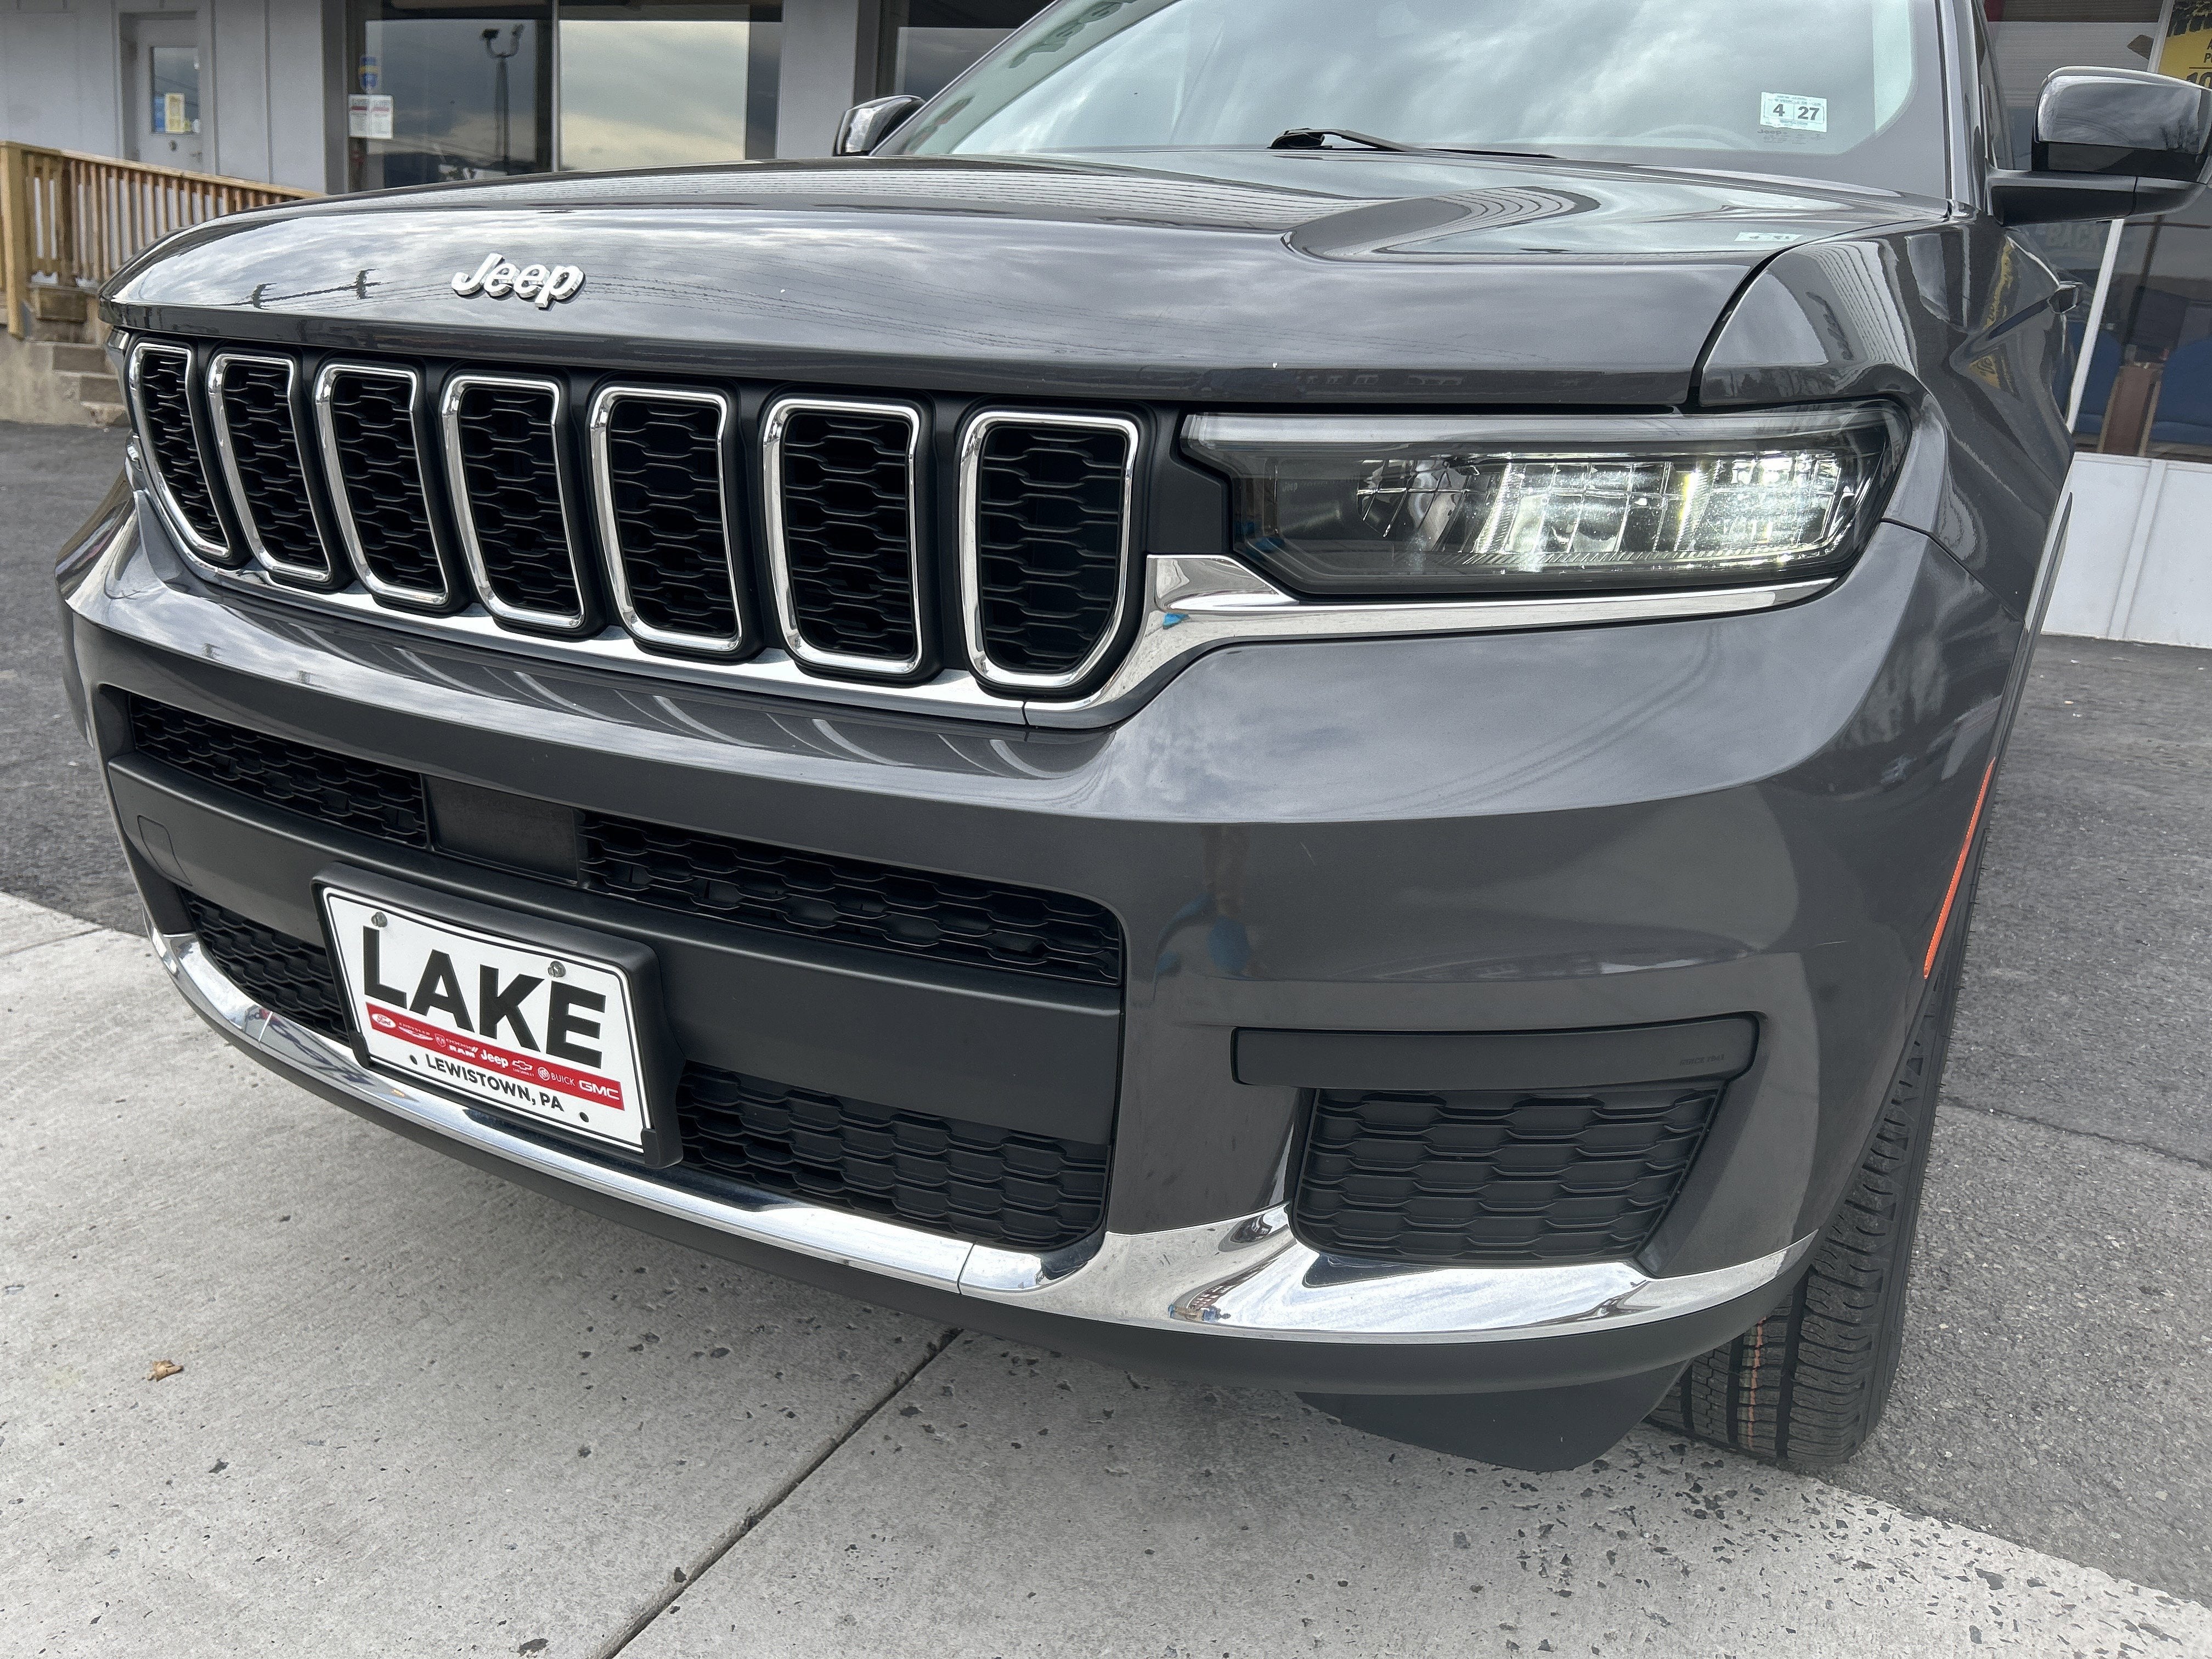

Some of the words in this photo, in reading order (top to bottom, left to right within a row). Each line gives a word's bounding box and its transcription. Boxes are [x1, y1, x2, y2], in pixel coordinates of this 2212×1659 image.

[1773, 104, 1785, 116] 4
[1798, 106, 1820, 121] 27
[451, 253, 586, 308] Jeep
[363, 925, 606, 1069] LAKE
[376, 1014, 391, 1026] Ford
[449, 1044, 476, 1059] RAM
[480, 1049, 509, 1069] Jeep
[425, 1053, 536, 1105] LEWISTOWN,
[539, 1091, 565, 1112] PA
[551, 1072, 575, 1087] BUICK
[579, 1080, 620, 1101] GMC
